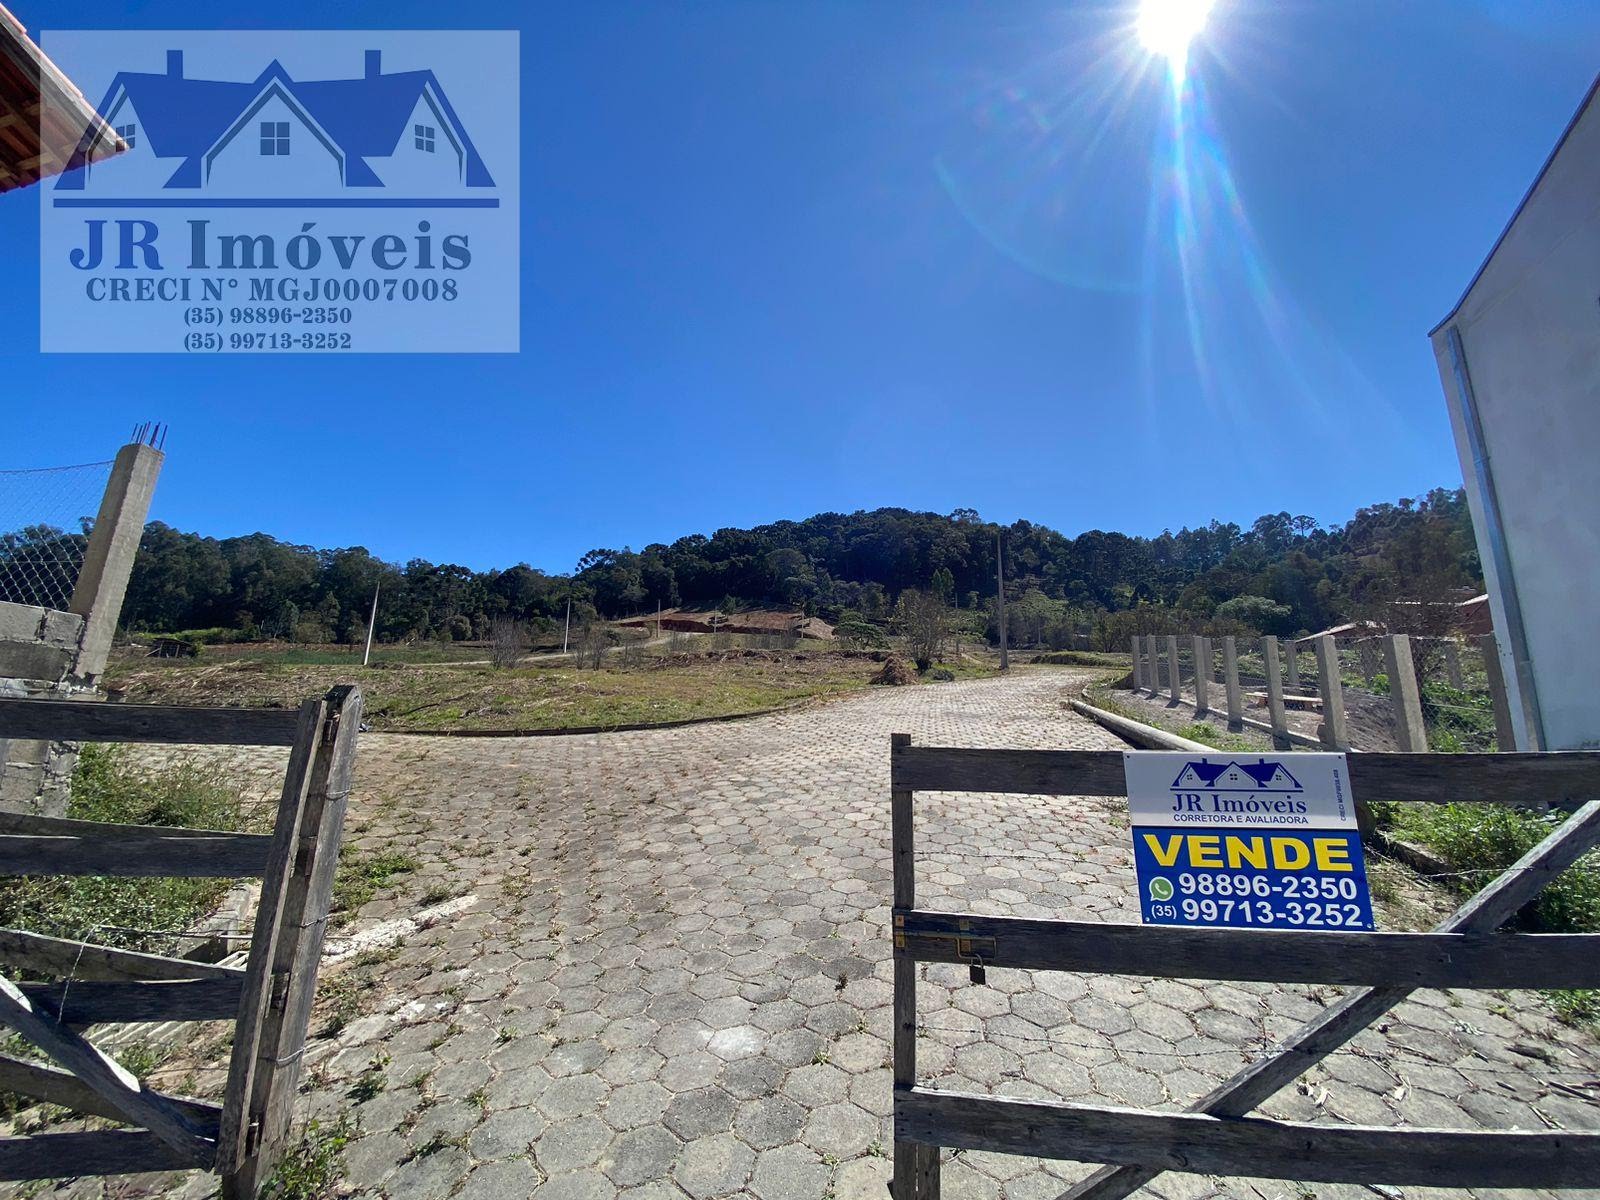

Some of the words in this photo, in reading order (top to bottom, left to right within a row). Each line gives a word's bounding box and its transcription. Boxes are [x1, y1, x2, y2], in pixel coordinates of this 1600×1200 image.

[1172, 793, 1205, 812] JR
[1211, 794, 1307, 814] Imóveis
[1173, 813, 1235, 823] CORRETORA
[1236, 815, 1243, 823] E
[1244, 815, 1309, 825] AVALIADORA
[1142, 833, 1354, 872] VENDE
[1178, 872, 1358, 900] 98896-2350
[1151, 904, 1177, 920] (35)
[1181, 898, 1364, 927] 99713-3252
